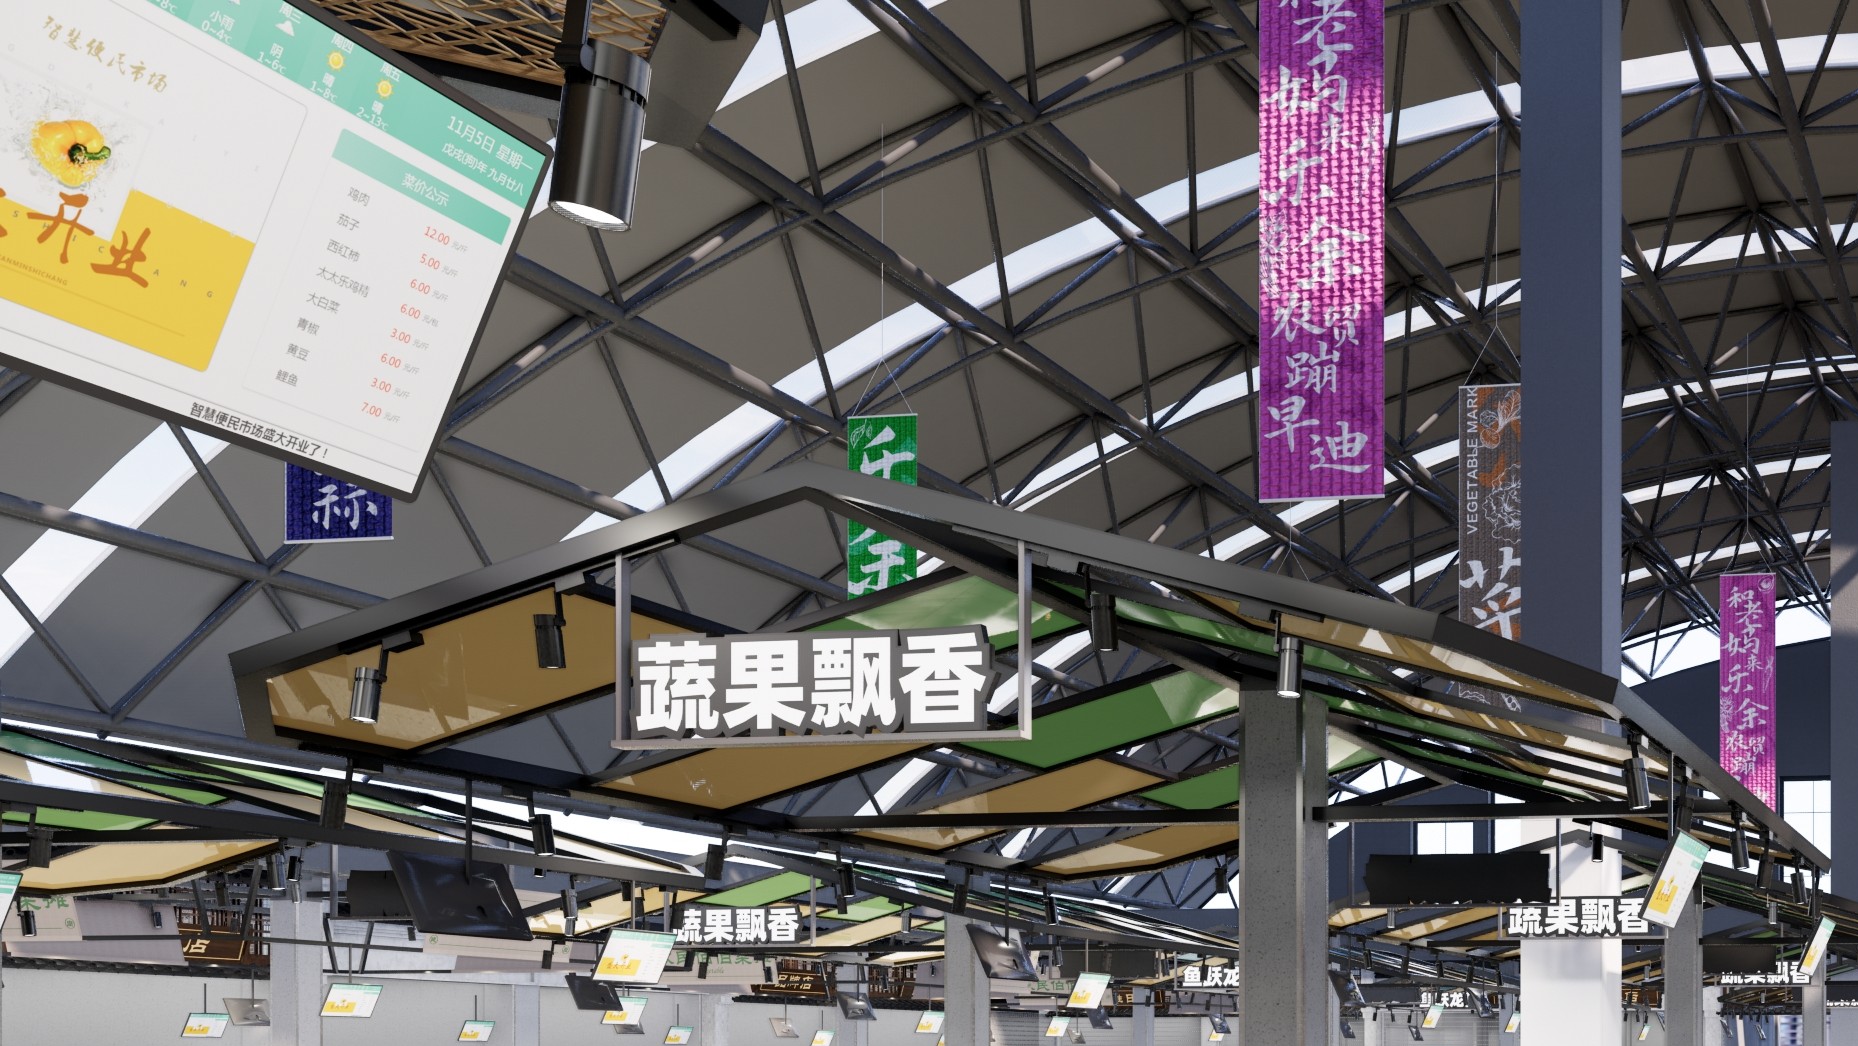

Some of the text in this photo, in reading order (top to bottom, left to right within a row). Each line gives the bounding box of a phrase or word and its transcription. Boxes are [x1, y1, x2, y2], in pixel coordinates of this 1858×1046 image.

[210, 10, 235, 32] 小雨
[331, 34, 354, 54] 周四
[380, 61, 401, 81] 周五
[497, 141, 533, 171] 星期一
[402, 173, 449, 208] 菜价公示
[348, 186, 370, 206] 鸡肉
[424, 226, 450, 245] 12.00
[337, 213, 360, 231] 茄子
[420, 253, 440, 270] 5.00
[327, 239, 361, 263] 西红柿
[410, 279, 430, 294] 6.00
[306, 292, 341, 314] 大白菜
[391, 328, 411, 344] 3.00
[401, 303, 421, 319] 6.00
[381, 353, 401, 369] 6.00
[371, 378, 392, 393] 3.00
[361, 402, 382, 417] 7.00
[1467, 438, 1478, 535] VEGETABLE
[635, 632, 986, 731] 蔬果飘香
[673, 908, 799, 943] 蔬果飘香
[1508, 898, 1648, 936] 蔬果飘香
